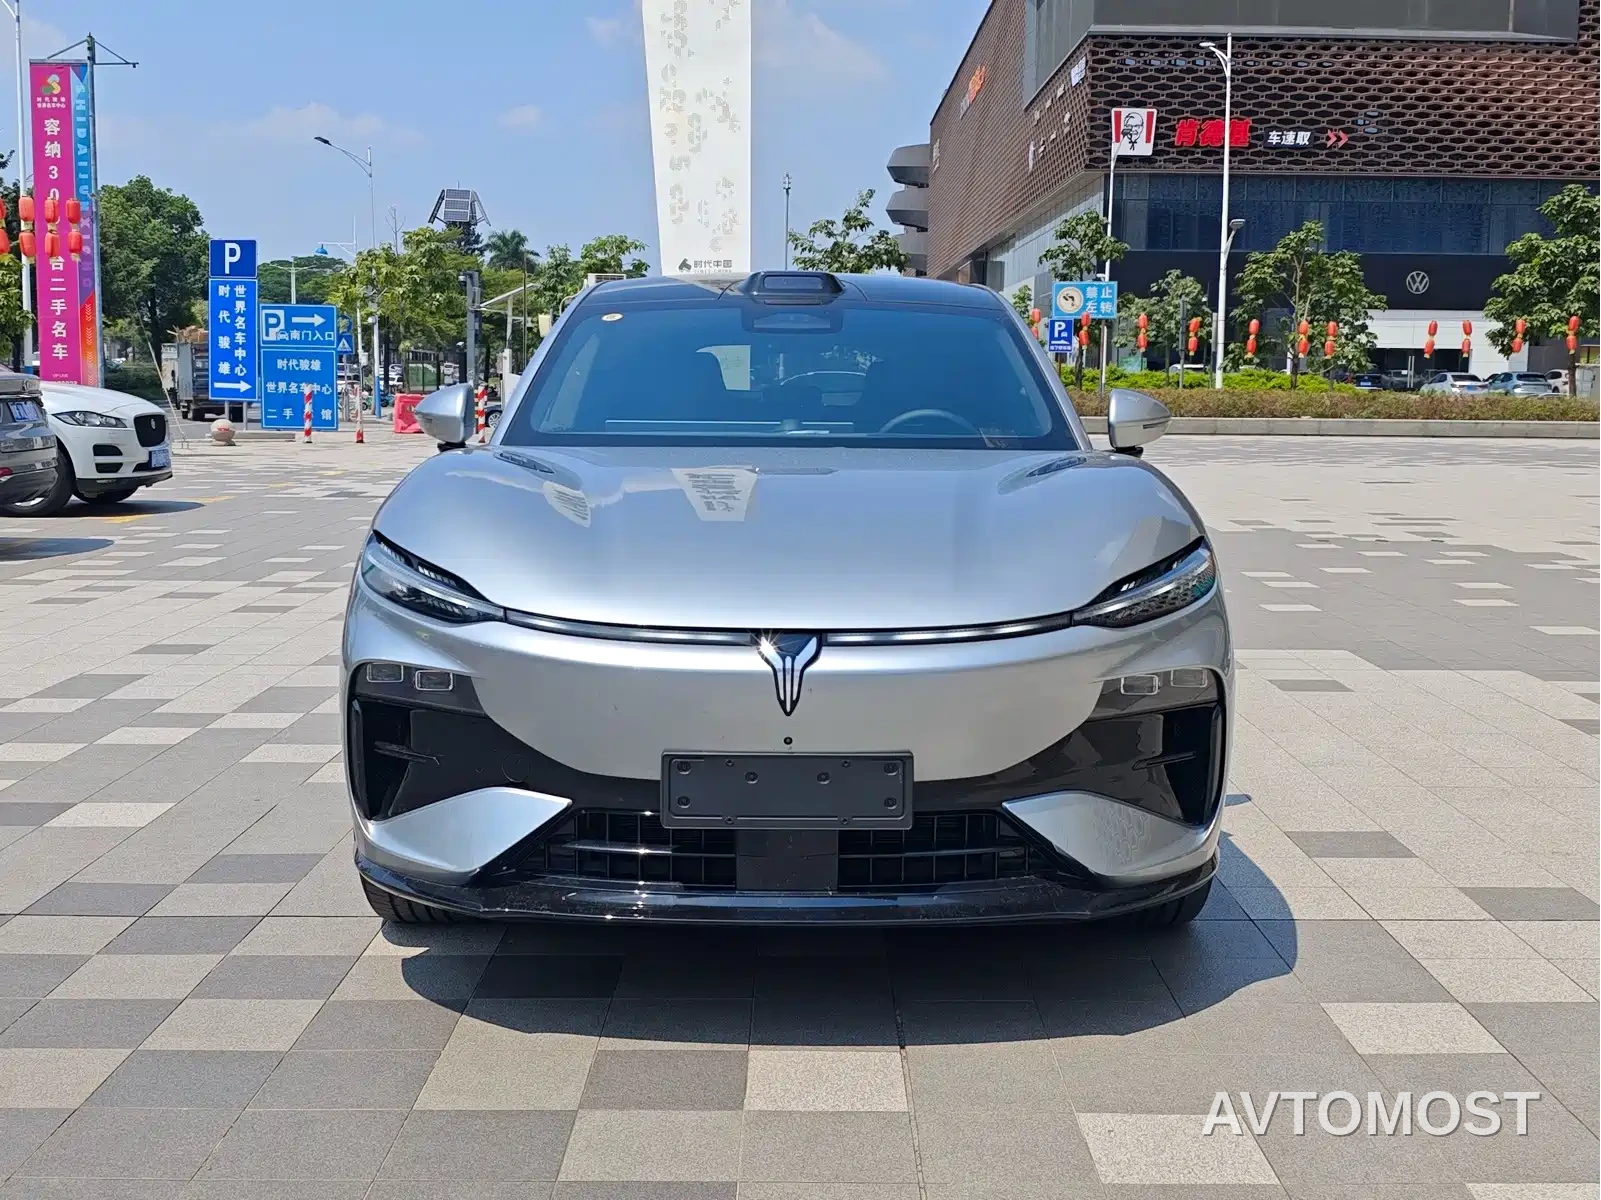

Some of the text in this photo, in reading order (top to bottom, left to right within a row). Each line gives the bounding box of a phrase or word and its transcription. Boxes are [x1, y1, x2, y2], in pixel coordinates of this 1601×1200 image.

[1174, 118, 1250, 147] 肯德基
[1267, 130, 1311, 146] 车速取
[44, 118, 68, 360] 容纳30台二手名车
[224, 242, 241, 275] P
[693, 259, 733, 268] 时代中国
[1085, 286, 1113, 299] 禁止
[1085, 300, 1113, 313] 左转
[218, 285, 231, 375] 时代骏雄
[234, 284, 247, 377] 世界名车中心
[263, 312, 282, 340] P
[1054, 321, 1066, 338] P
[290, 329, 334, 341] 南门入口
[276, 358, 322, 372] 时代骏雄
[266, 408, 332, 421] 二手馆
